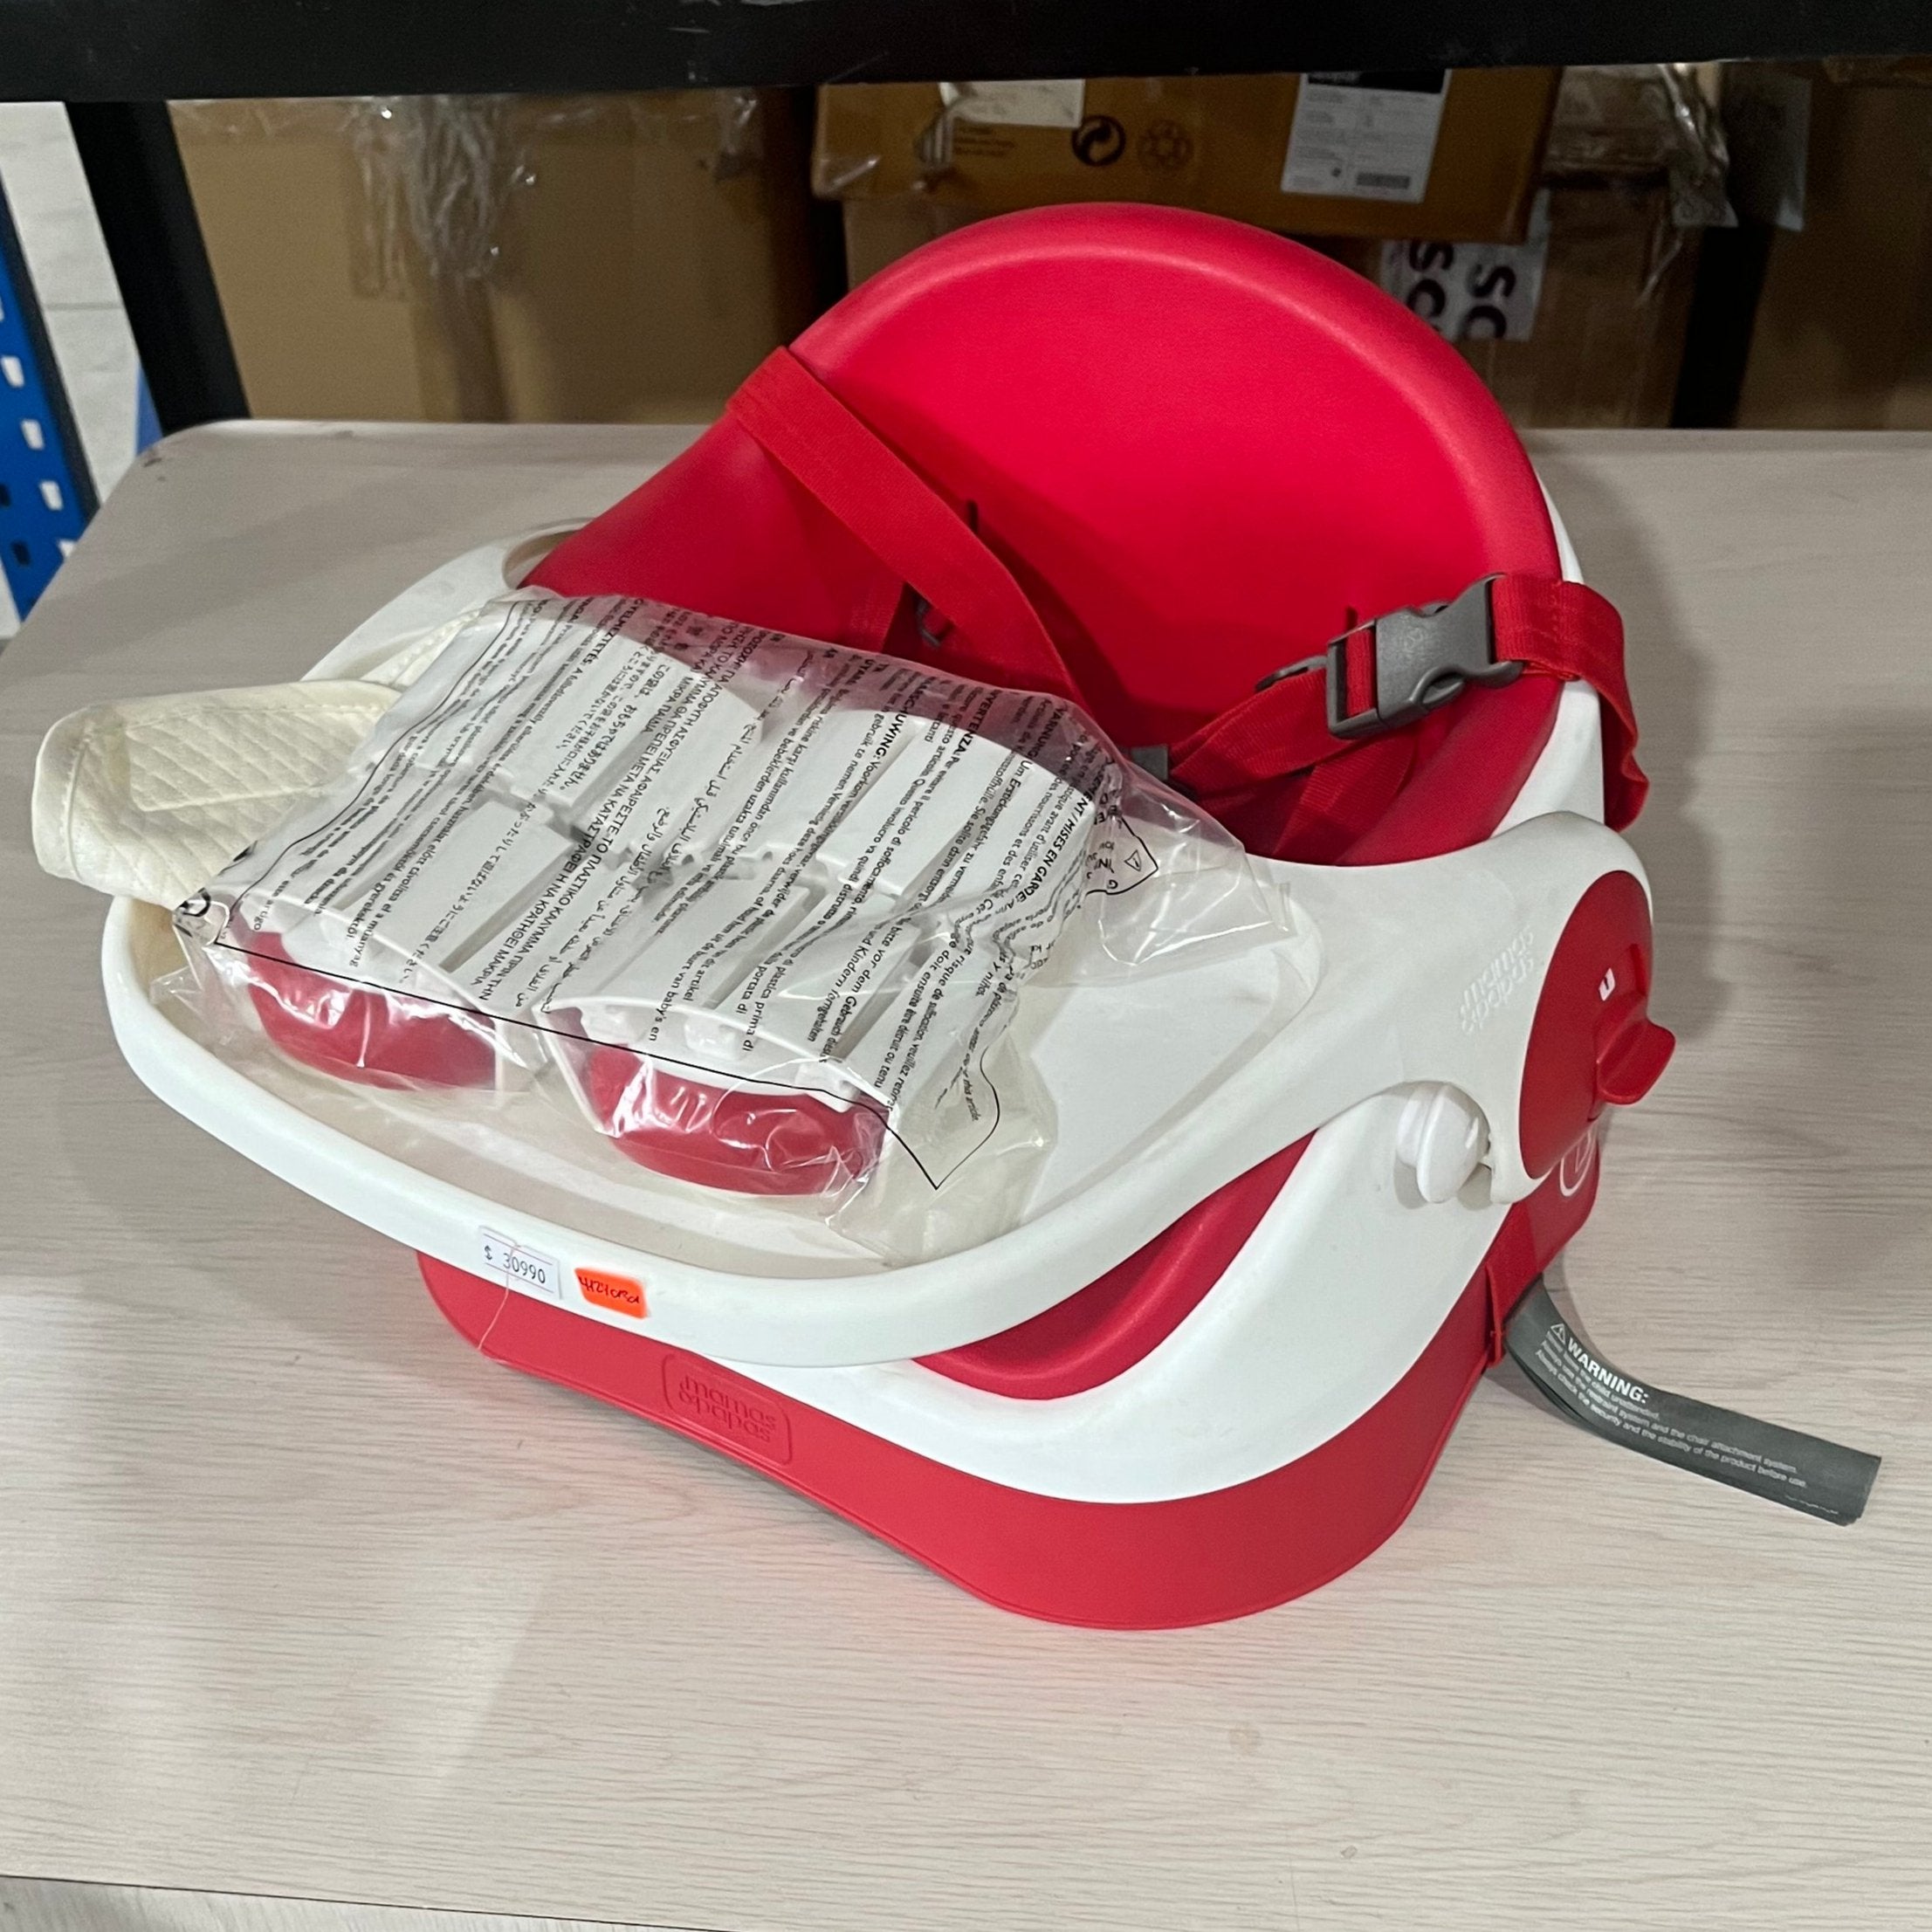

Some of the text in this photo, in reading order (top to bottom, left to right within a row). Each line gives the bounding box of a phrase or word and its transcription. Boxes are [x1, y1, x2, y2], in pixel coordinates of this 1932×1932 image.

[716, 650, 733, 663] ΤΟ
[572, 667, 583, 677] A
[670, 705, 687, 718] ΘΑ
[684, 682, 722, 725] ΑΠΟΦΥΓΗ
[642, 719, 677, 755] ΠΡΕΠΕΙ
[787, 727, 799, 737] ve
[801, 715, 823, 742] riskine
[860, 713, 884, 746] gebruik
[754, 738, 794, 792] bebeklerden
[786, 743, 808, 766] karşı
[854, 747, 865, 759] te
[622, 755, 649, 782] ΜΕΤΑ
[705, 779, 720, 797] قبل
[717, 743, 742, 780] استخدام
[1014, 760, 1033, 776] Um
[610, 783, 629, 797] ΝΑ
[734, 794, 757, 823] uzakta
[897, 801, 924, 835] pericolo
[563, 799, 616, 873] ΚΑΤΑΣΤΡΑΦΕΙ
[873, 807, 904, 843] involucro
[941, 805, 987, 867] Sie sollte dann
[1052, 818, 1075, 850] MISES
[416, 843, 436, 865] előtt
[595, 835, 614, 854] ΤΟ
[865, 845, 877, 854] va
[890, 836, 901, 846] di
[1011, 838, 1022, 849] et
[1020, 810, 1059, 871] avant d'utiliser
[848, 855, 869, 883] quindi
[962, 852, 974, 863] zu
[1002, 849, 1017, 866] des
[1042, 849, 1057, 867] EN
[382, 871, 395, 882] és
[388, 866, 420, 901] távolítsa
[554, 873, 568, 883] Η
[558, 853, 602, 905] ΠΛΑΣΤΙΚΟ
[595, 899, 608, 911] عن
[607, 875, 632, 898] متناول
[628, 843, 652, 879] الأطفال
[851, 847, 894, 904] soffocamento,
[541, 882, 561, 897] ΝΑ
[381, 903, 391, 912] el
[504, 899, 548, 948] ΚΡΑΤΗΘΕΙ
[518, 906, 563, 953] ΚΑΛΥΜΜΑ
[349, 920, 378, 966] műanyag
[471, 949, 509, 985] ΜΑΚΡΙΑ
[835, 945, 869, 987] Kindern
[929, 949, 949, 971] doit
[938, 954, 965, 987] risque
[992, 960, 1001, 972] y
[478, 979, 502, 1000] ΤΗΝ
[670, 972, 685, 988] van
[683, 969, 705, 1001] artikel
[735, 962, 767, 1014] portata di
[830, 926, 902, 1035] bitte vor dem Gebrauch
[908, 971, 931, 1007] ensuite
[931, 987, 944, 1000] de
[654, 991, 678, 1022] baby's
[746, 1000, 765, 1035] prima
[648, 1026, 659, 1042] en
[742, 1039, 754, 1051] di
[883, 1051, 895, 1064] ou
[873, 1065, 890, 1088] tenu
[483, 1245, 547, 1284] $ 30990
[1569, 1337, 1648, 1403] WARNING:
[682, 1377, 779, 1425] mamas
[1591, 1380, 1611, 1398] child
[1650, 1422, 1669, 1434] and
[1669, 1427, 1685, 1439] the
[1686, 1434, 1709, 1446] chair
[1622, 1421, 1641, 1434] and
[1640, 1428, 1656, 1440] the
[1704, 1449, 1720, 1460] the
[1720, 1454, 1757, 1472] product
[1757, 1465, 1786, 1481] before
